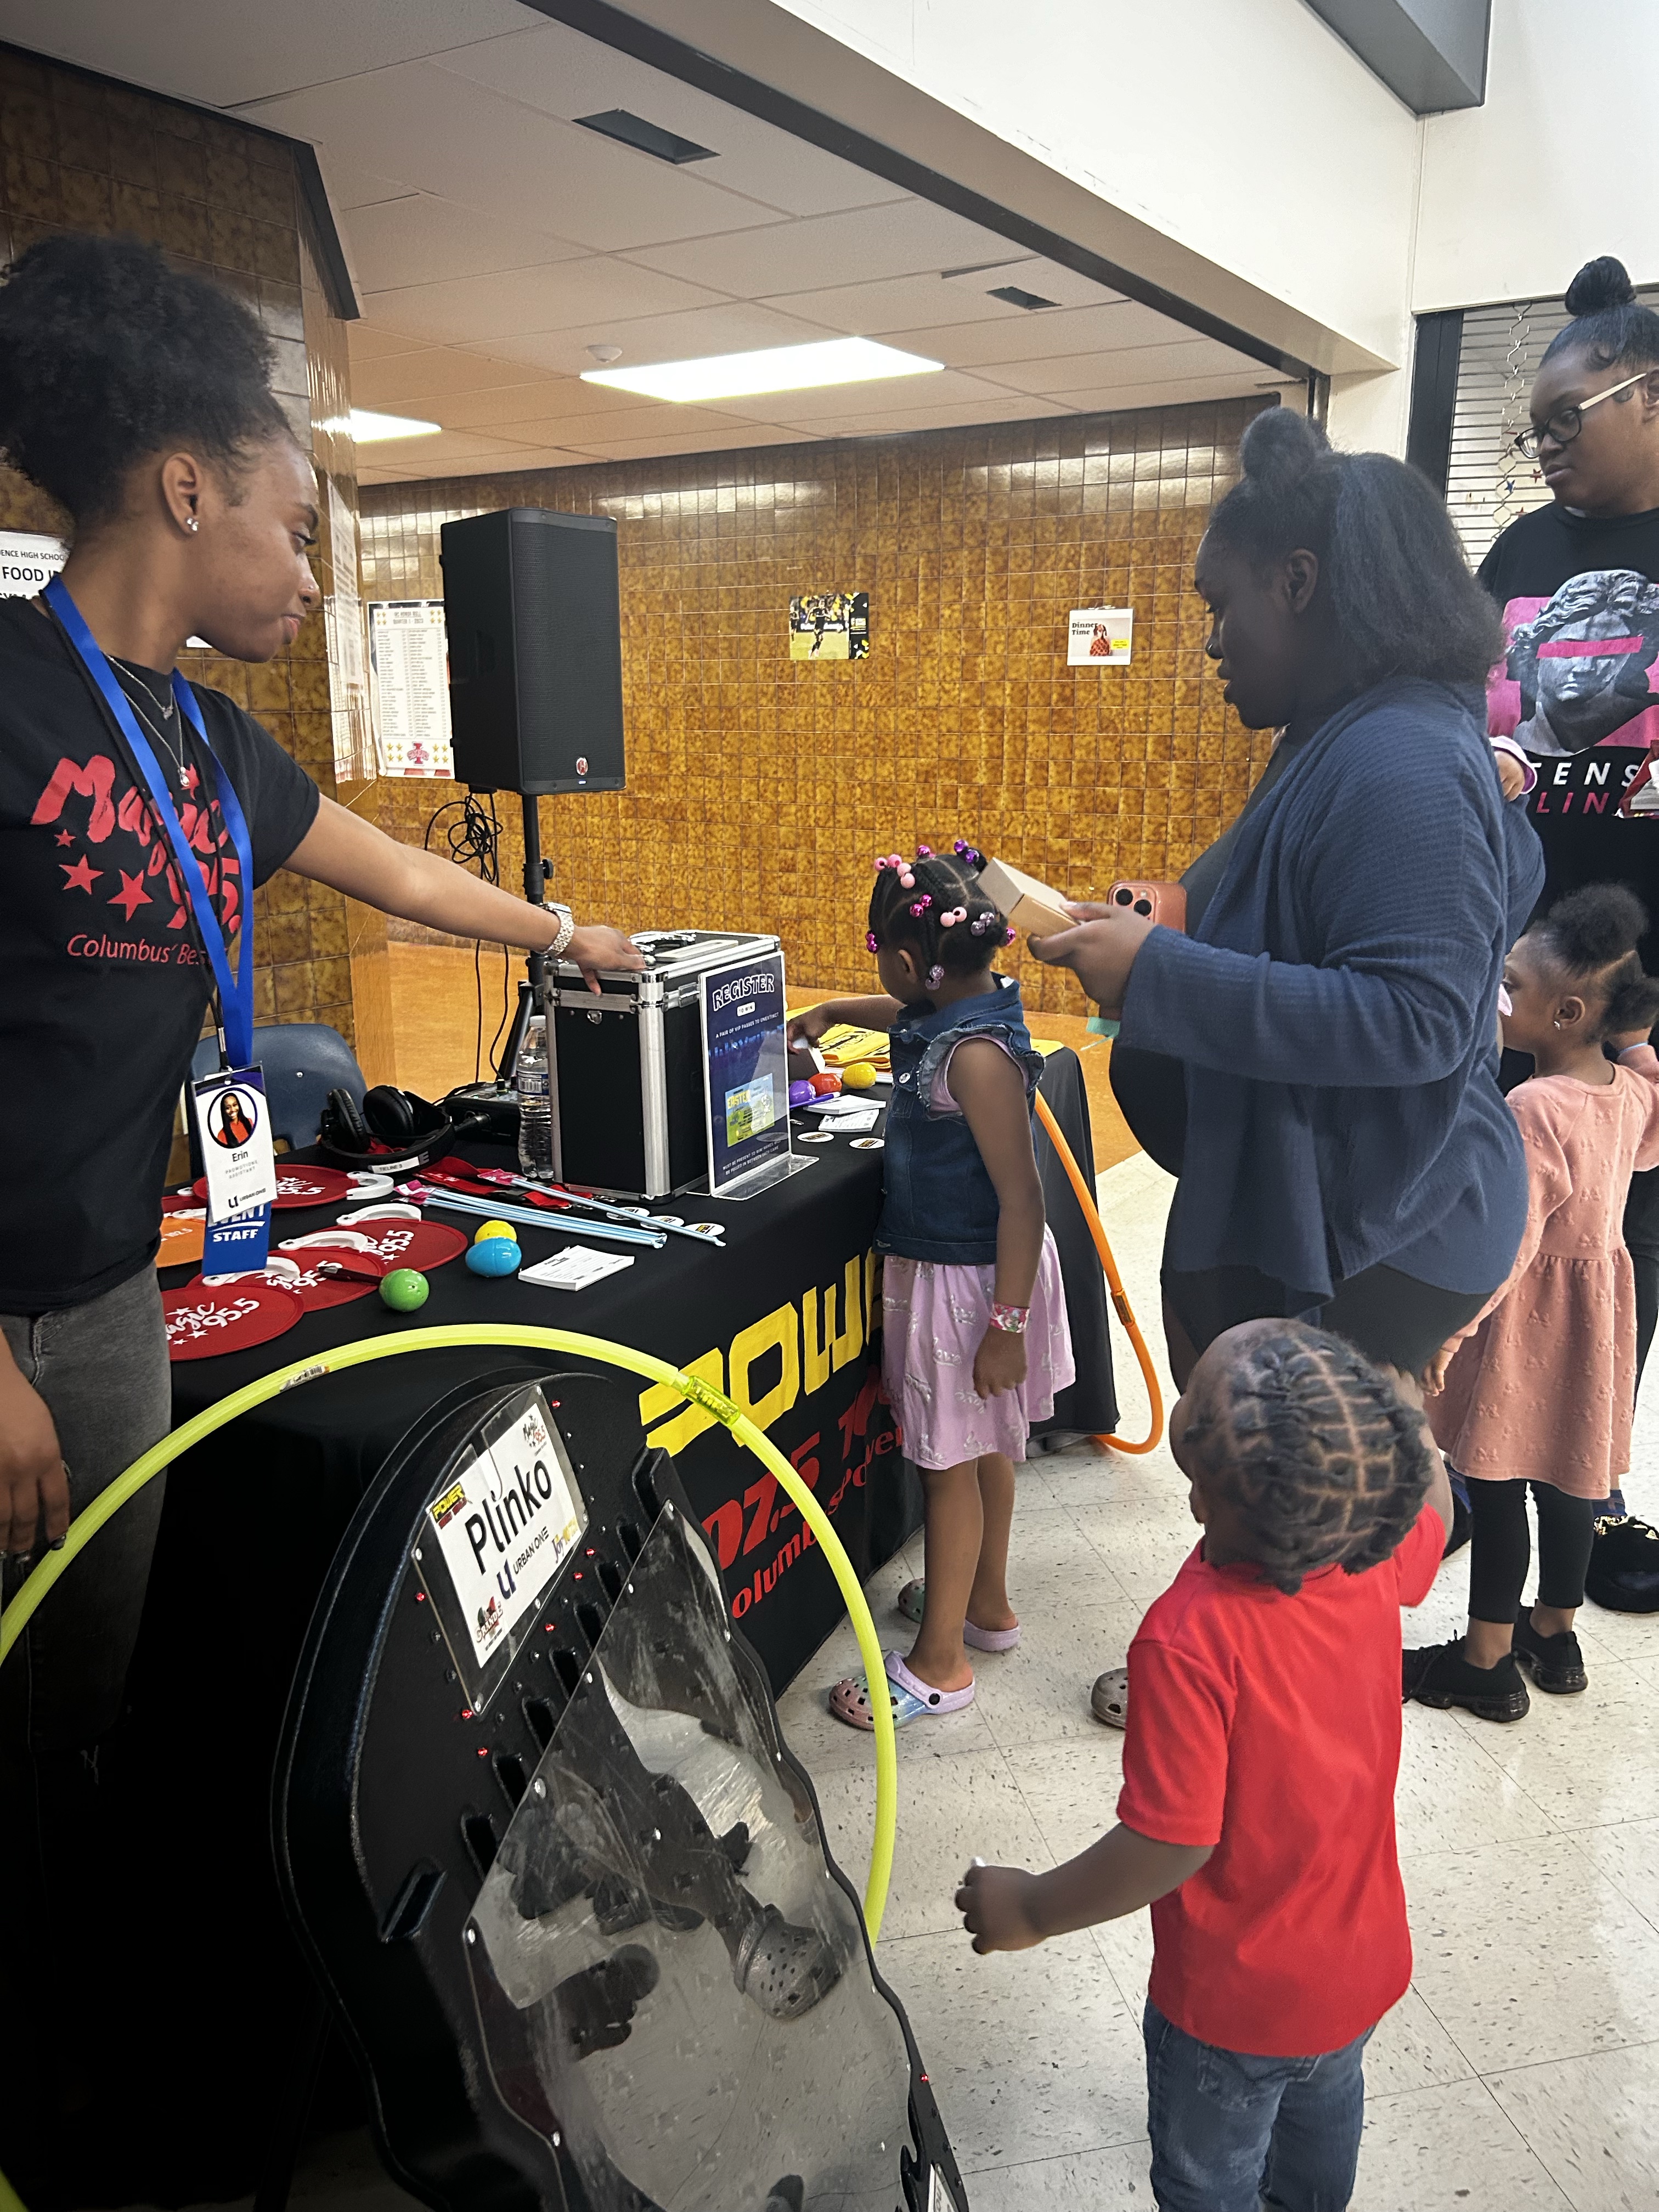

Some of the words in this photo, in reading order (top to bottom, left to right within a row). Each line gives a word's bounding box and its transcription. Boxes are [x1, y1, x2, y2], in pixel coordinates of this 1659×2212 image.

[0, 549, 19, 557] ENCE
[40, 552, 64, 561] SCHOO
[2, 566, 44, 582] FOOD
[712, 973, 775, 1012] REGISTER
[741, 1020, 755, 1029] PASSES
[232, 1150, 249, 1163] Erin
[213, 1229, 258, 1243] STAFF
[166, 1301, 215, 1340] agic
[202, 1297, 260, 1328] 95.5
[639, 1246, 883, 1458] POW
[432, 1484, 465, 1520] POWER
[465, 1459, 552, 1576] Plinko
[512, 1542, 535, 1575] URBAN
[534, 1526, 549, 1550] ONE
